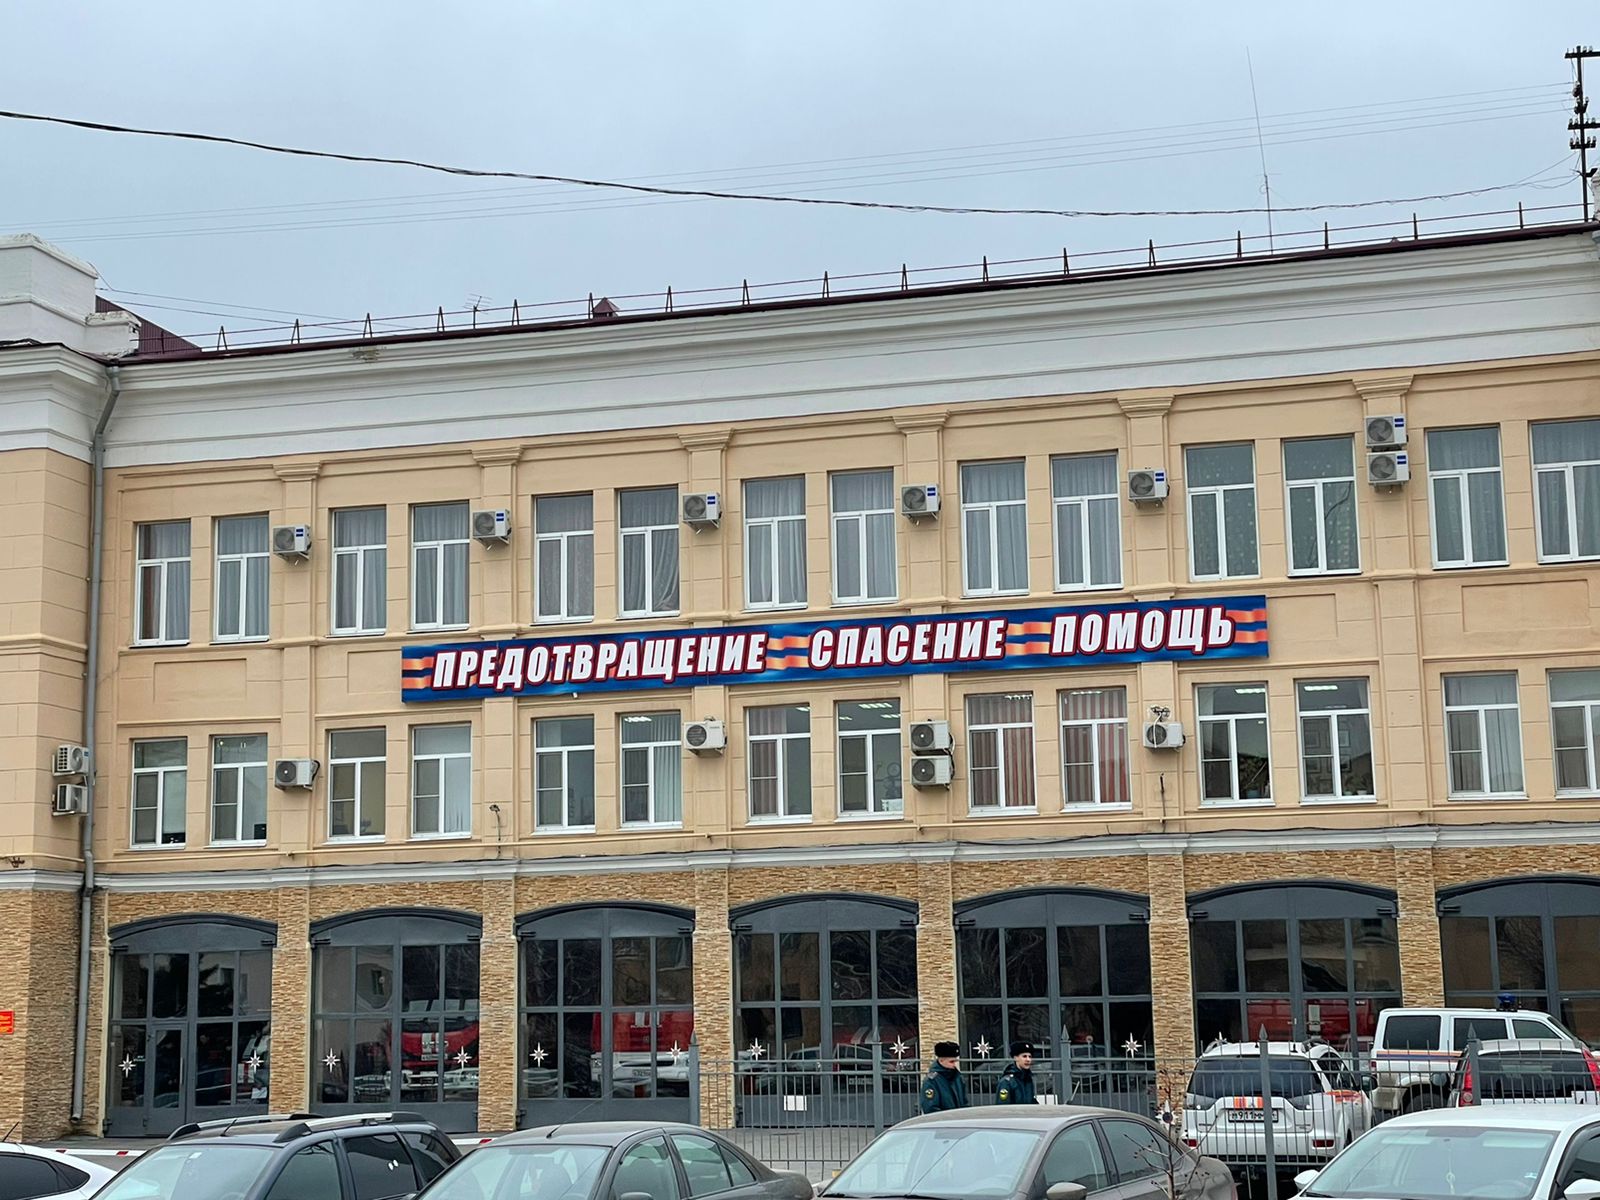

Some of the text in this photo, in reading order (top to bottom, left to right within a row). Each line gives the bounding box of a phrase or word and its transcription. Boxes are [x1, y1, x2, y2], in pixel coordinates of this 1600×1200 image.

[432, 606, 1234, 690] ПРЕДОТВРАЩЕНИЕ СПАСЕНИЕ ПОМОЩЬ
